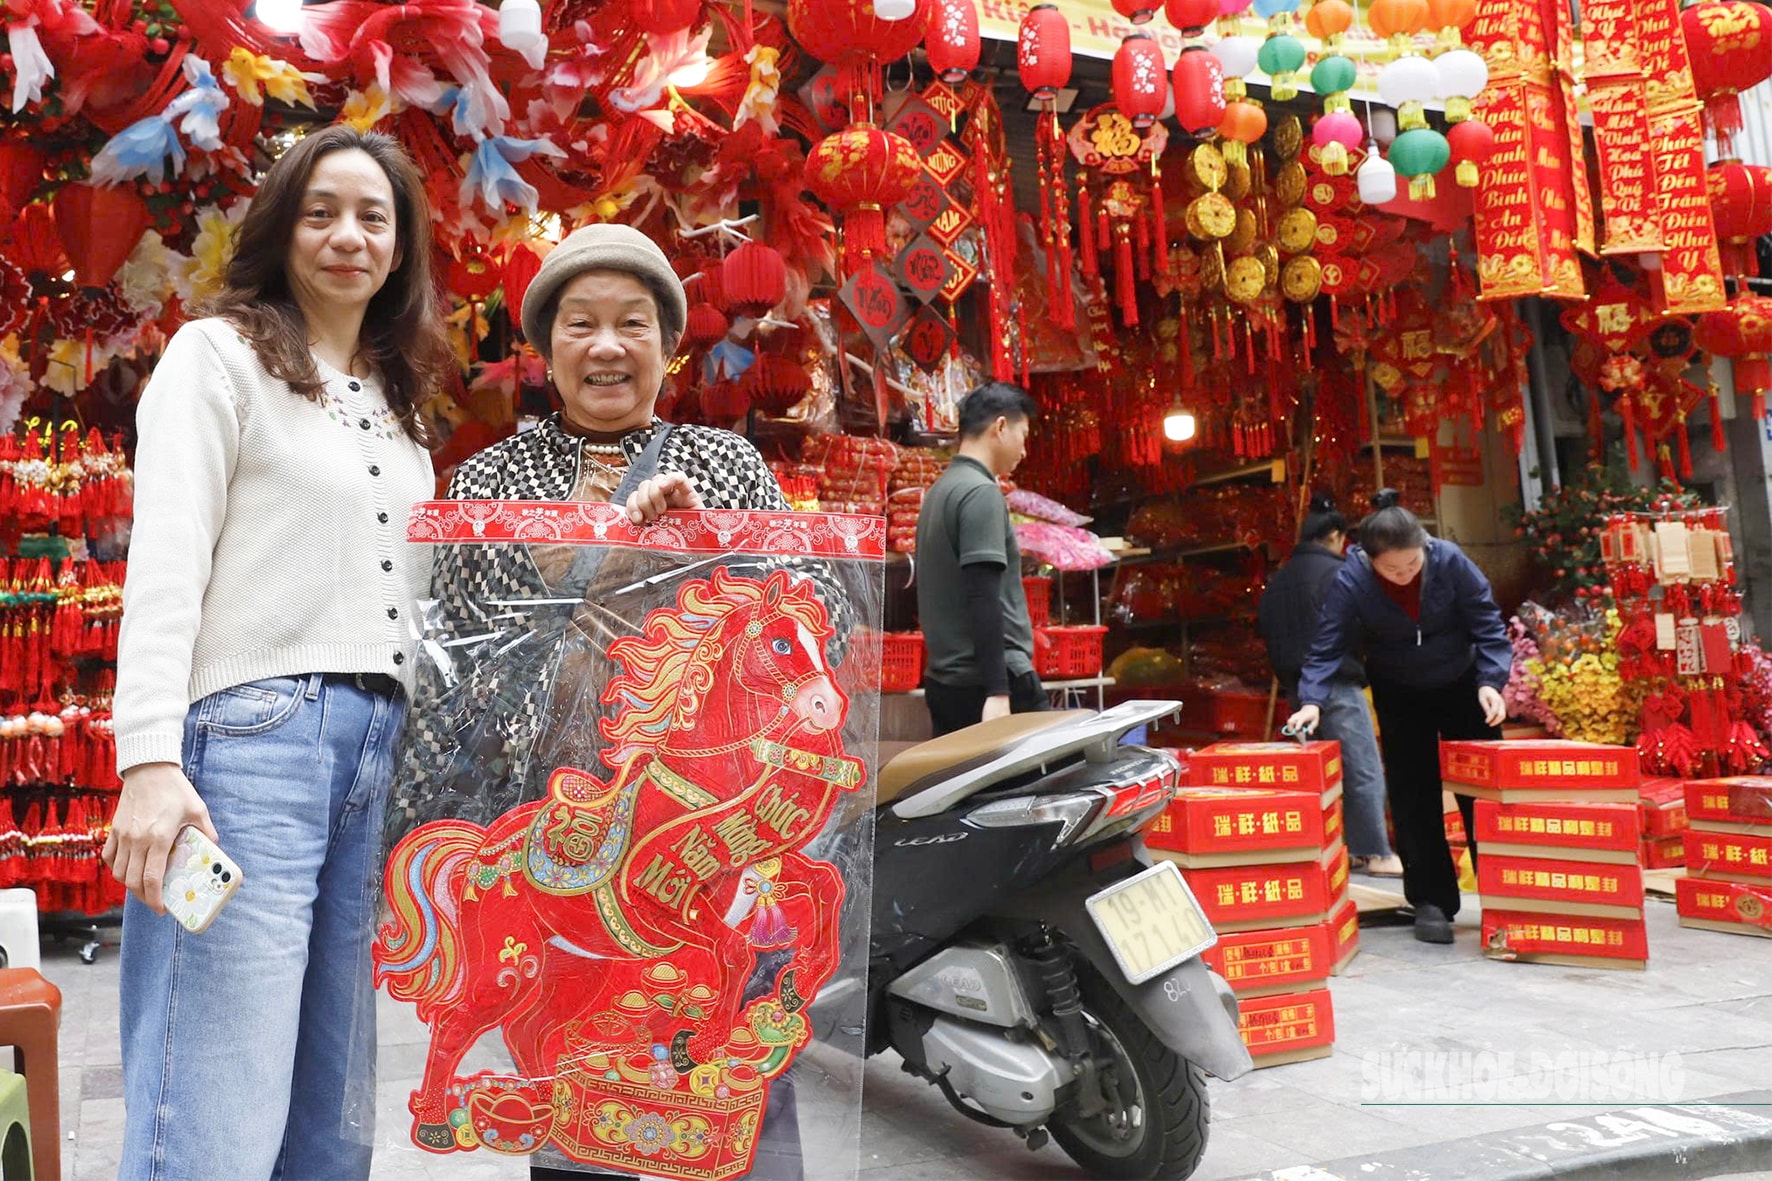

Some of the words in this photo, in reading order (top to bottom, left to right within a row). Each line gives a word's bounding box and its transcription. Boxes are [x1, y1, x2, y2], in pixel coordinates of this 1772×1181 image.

[1603, 128, 1643, 146] Vinh
[1608, 163, 1645, 181] Phú
[1656, 153, 1690, 173] Tết
[1480, 169, 1528, 190] Phúc
[1656, 172, 1697, 192] Đến
[1482, 187, 1528, 208] Bình
[1656, 192, 1707, 212] Trăm
[1491, 209, 1522, 229] An
[753, 782, 810, 840] Chúc
[546, 805, 603, 862] 福
[711, 807, 773, 868] Mừng
[669, 823, 721, 881] Năm
[632, 852, 692, 910] Mới
